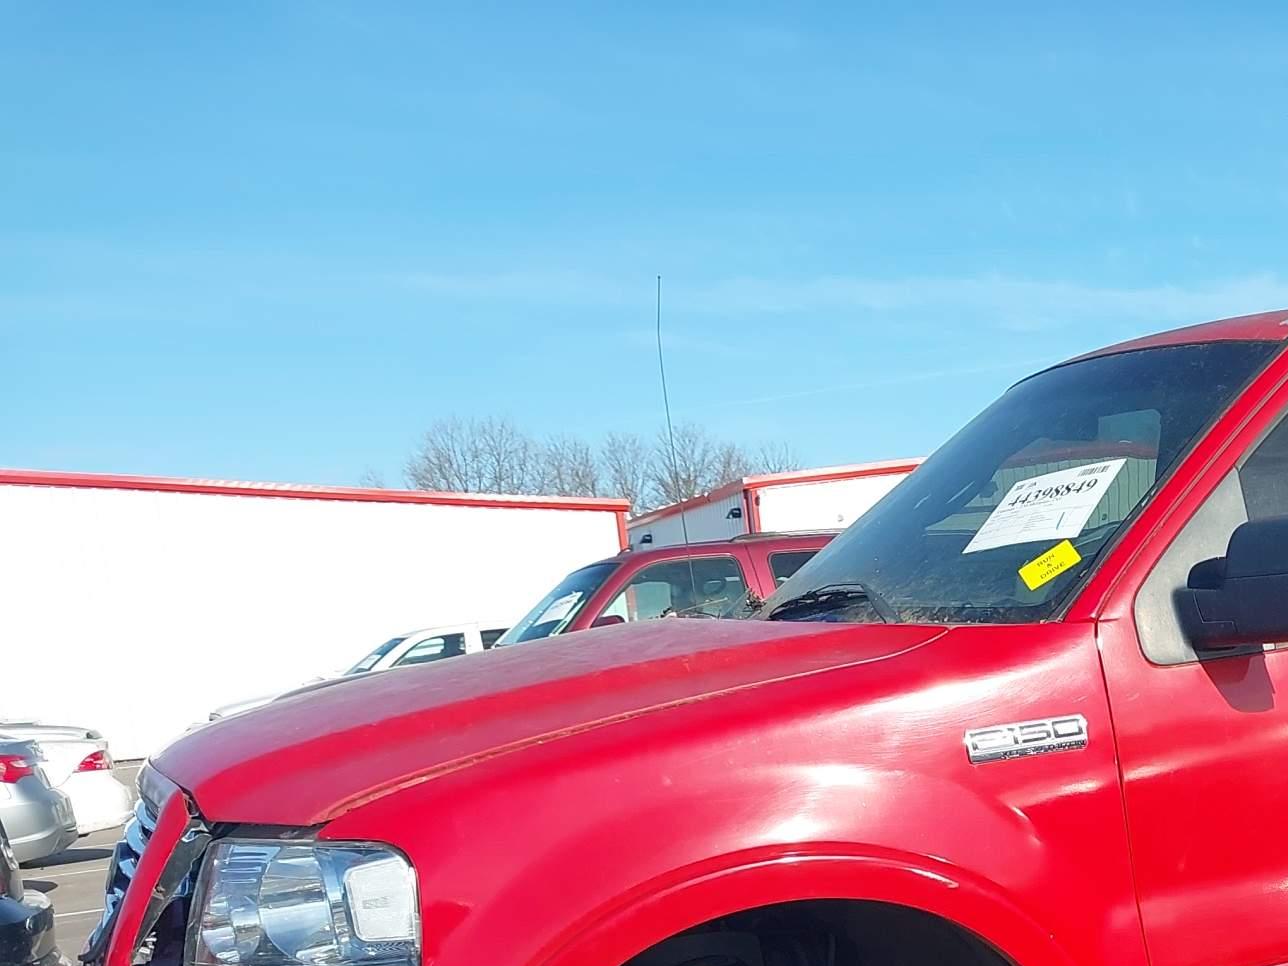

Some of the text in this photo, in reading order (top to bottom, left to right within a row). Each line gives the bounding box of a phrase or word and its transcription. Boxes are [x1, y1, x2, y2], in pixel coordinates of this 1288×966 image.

[1007, 478, 1098, 506] 44398849
[1036, 553, 1055, 567] RUN
[1040, 561, 1066, 580] DRIVE
